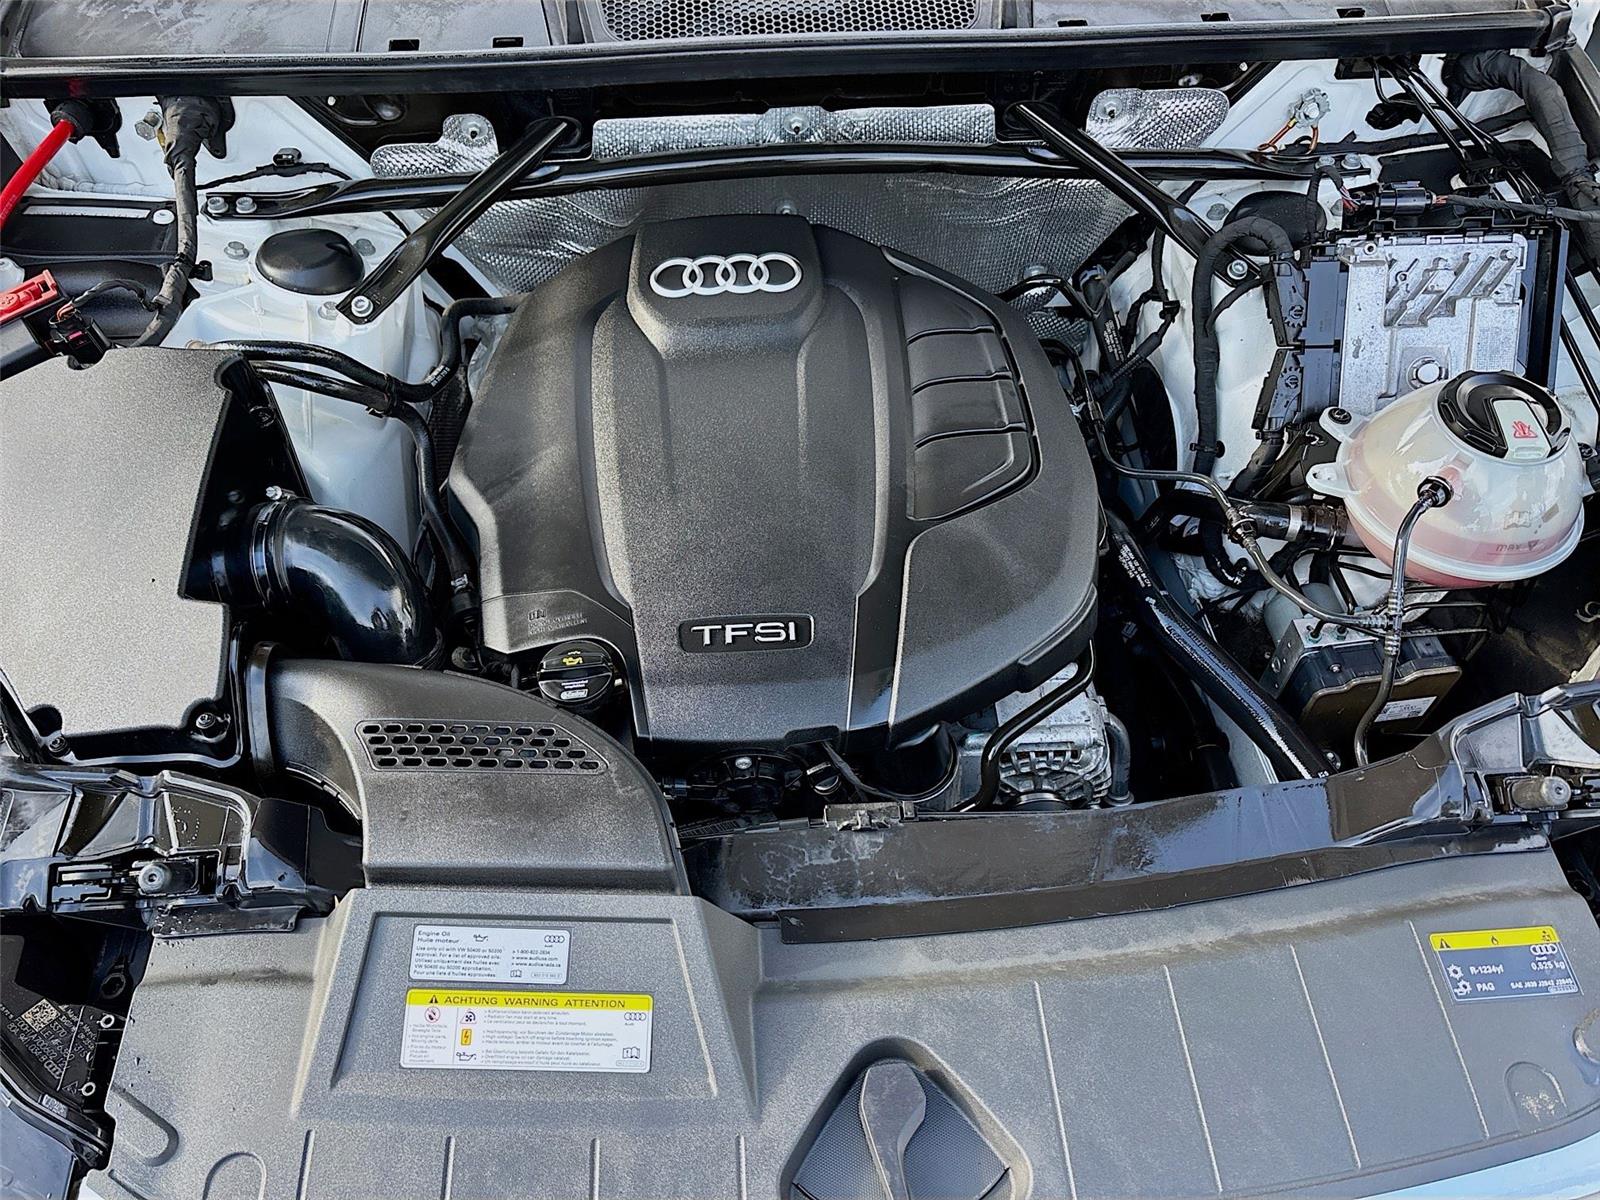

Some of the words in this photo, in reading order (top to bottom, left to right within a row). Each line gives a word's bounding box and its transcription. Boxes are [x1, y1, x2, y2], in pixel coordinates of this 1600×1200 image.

[690, 621, 796, 646] TFSI
[1555, 960, 1566, 970] kg
[1476, 982, 1496, 992] PAG
[444, 996, 498, 1005] ACHTUNG
[504, 997, 558, 1006] WARNING
[564, 998, 625, 1007] ATTENTION
